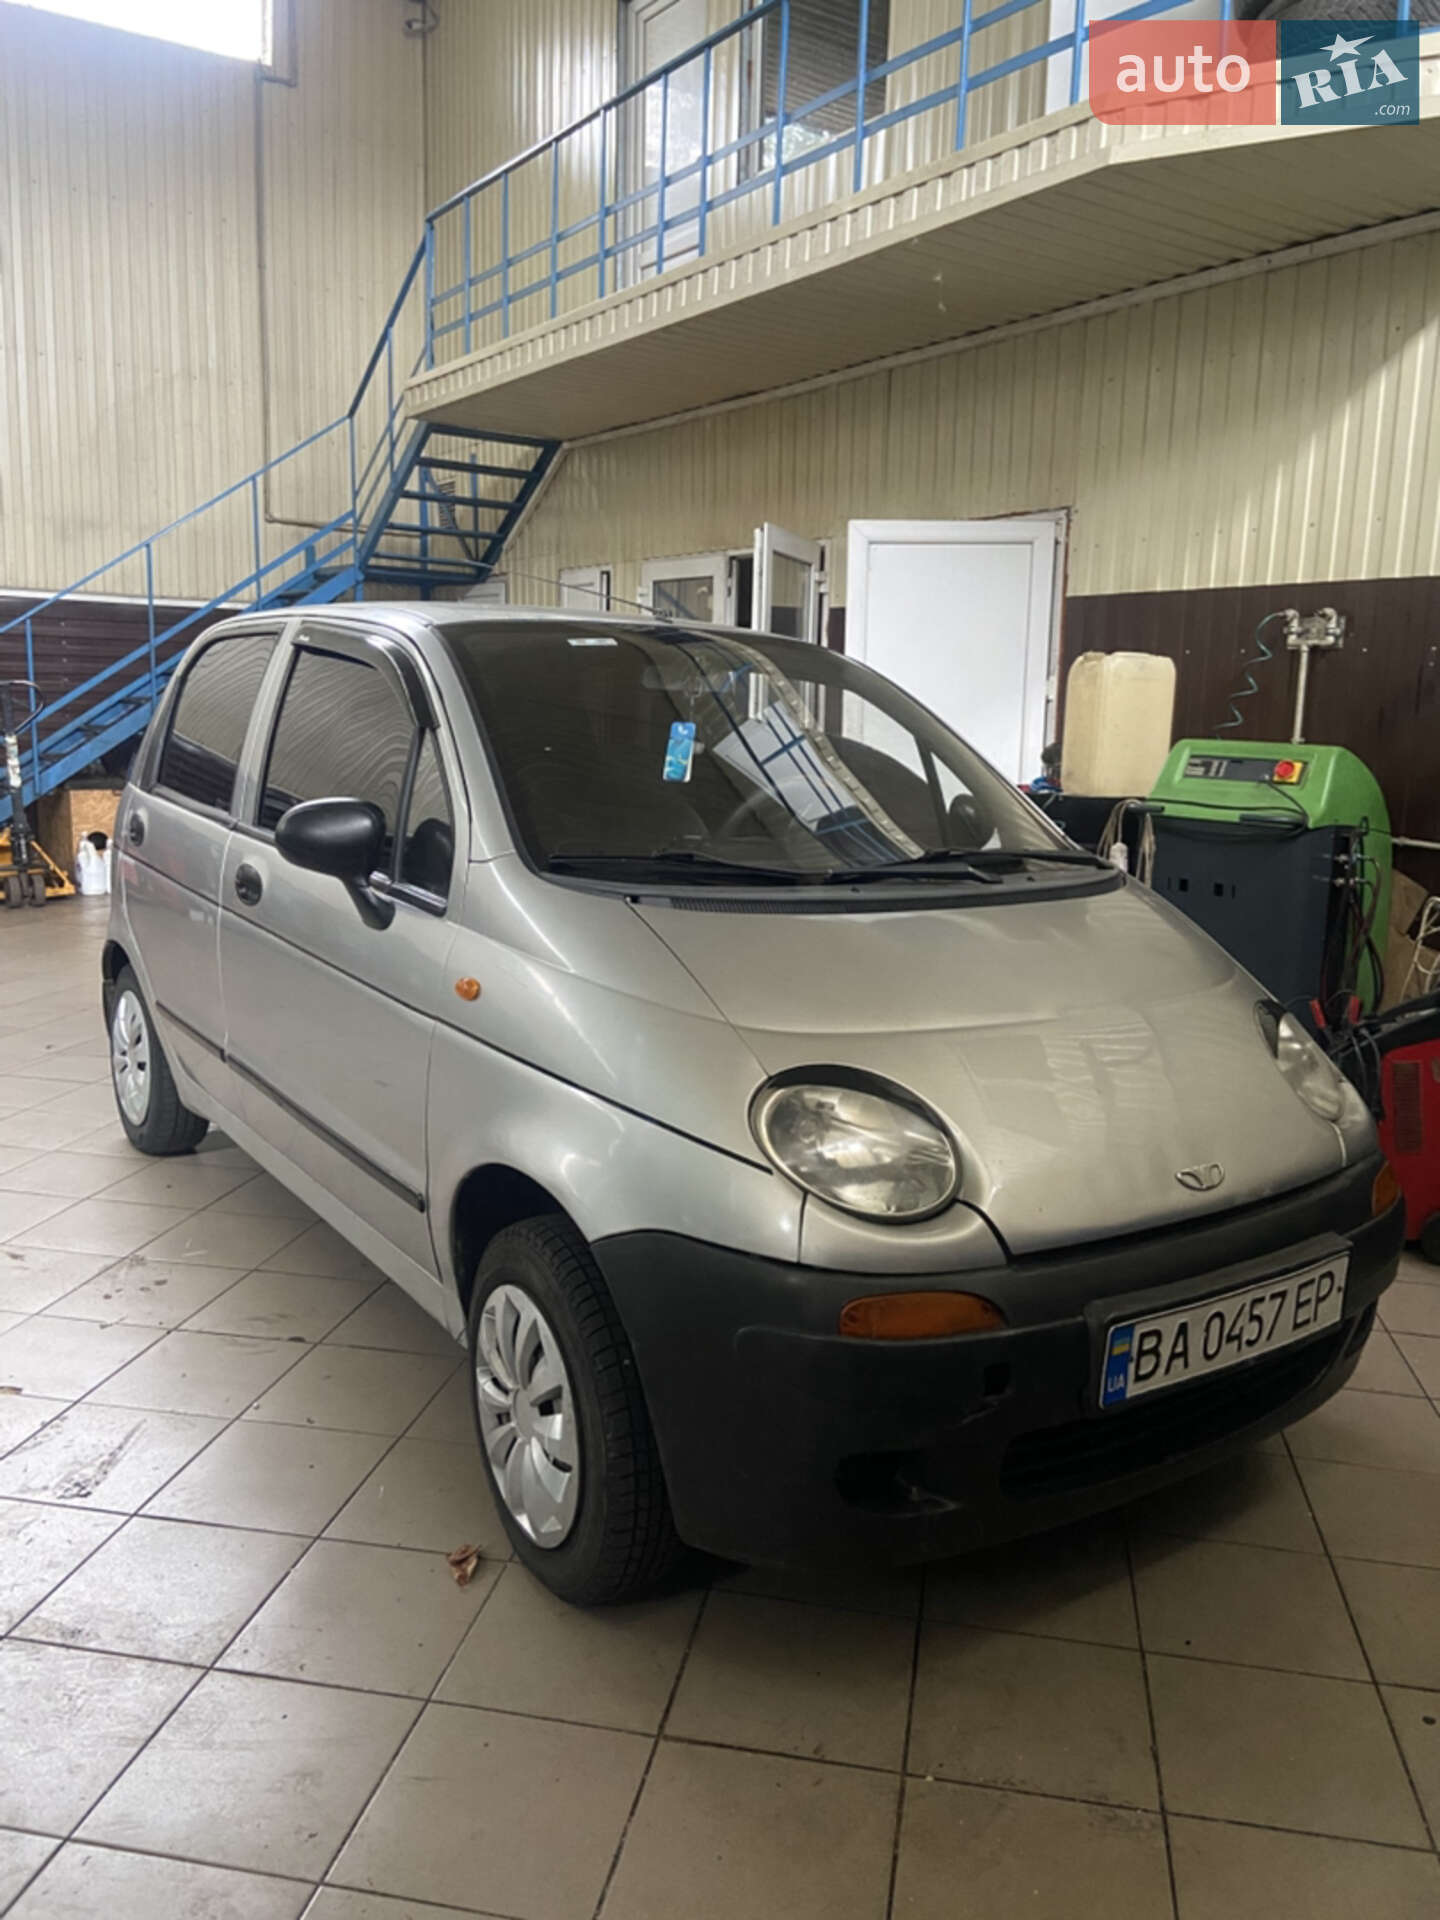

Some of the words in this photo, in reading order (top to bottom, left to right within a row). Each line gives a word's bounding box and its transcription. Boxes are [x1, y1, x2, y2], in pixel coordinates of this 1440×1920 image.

[1133, 1320, 1190, 1383] BA
[1202, 1290, 1288, 1361] 0457
[1292, 1270, 1335, 1331] EP
[1107, 1372, 1125, 1393] UA
